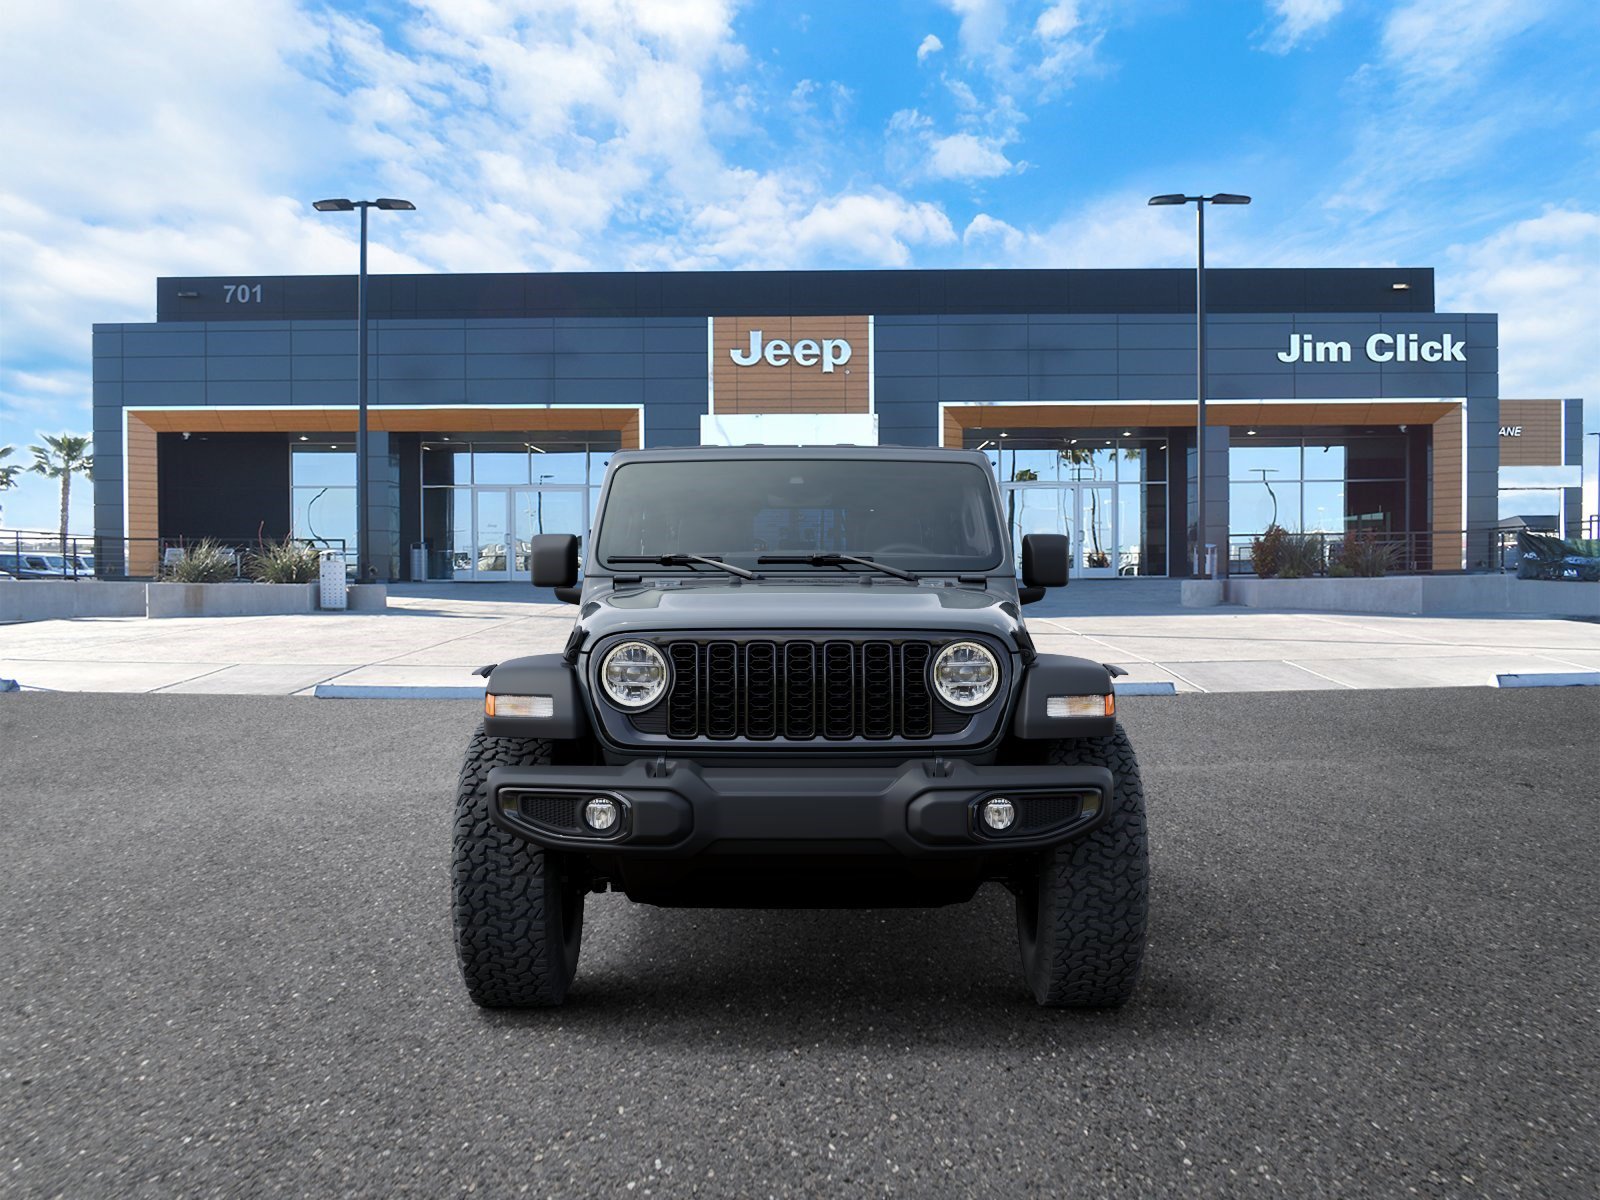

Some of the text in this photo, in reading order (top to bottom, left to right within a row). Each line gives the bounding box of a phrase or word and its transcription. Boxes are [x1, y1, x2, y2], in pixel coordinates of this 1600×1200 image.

[223, 284, 262, 304] 701
[729, 330, 852, 374] Jeep
[1277, 333, 1467, 363] Jim Click
